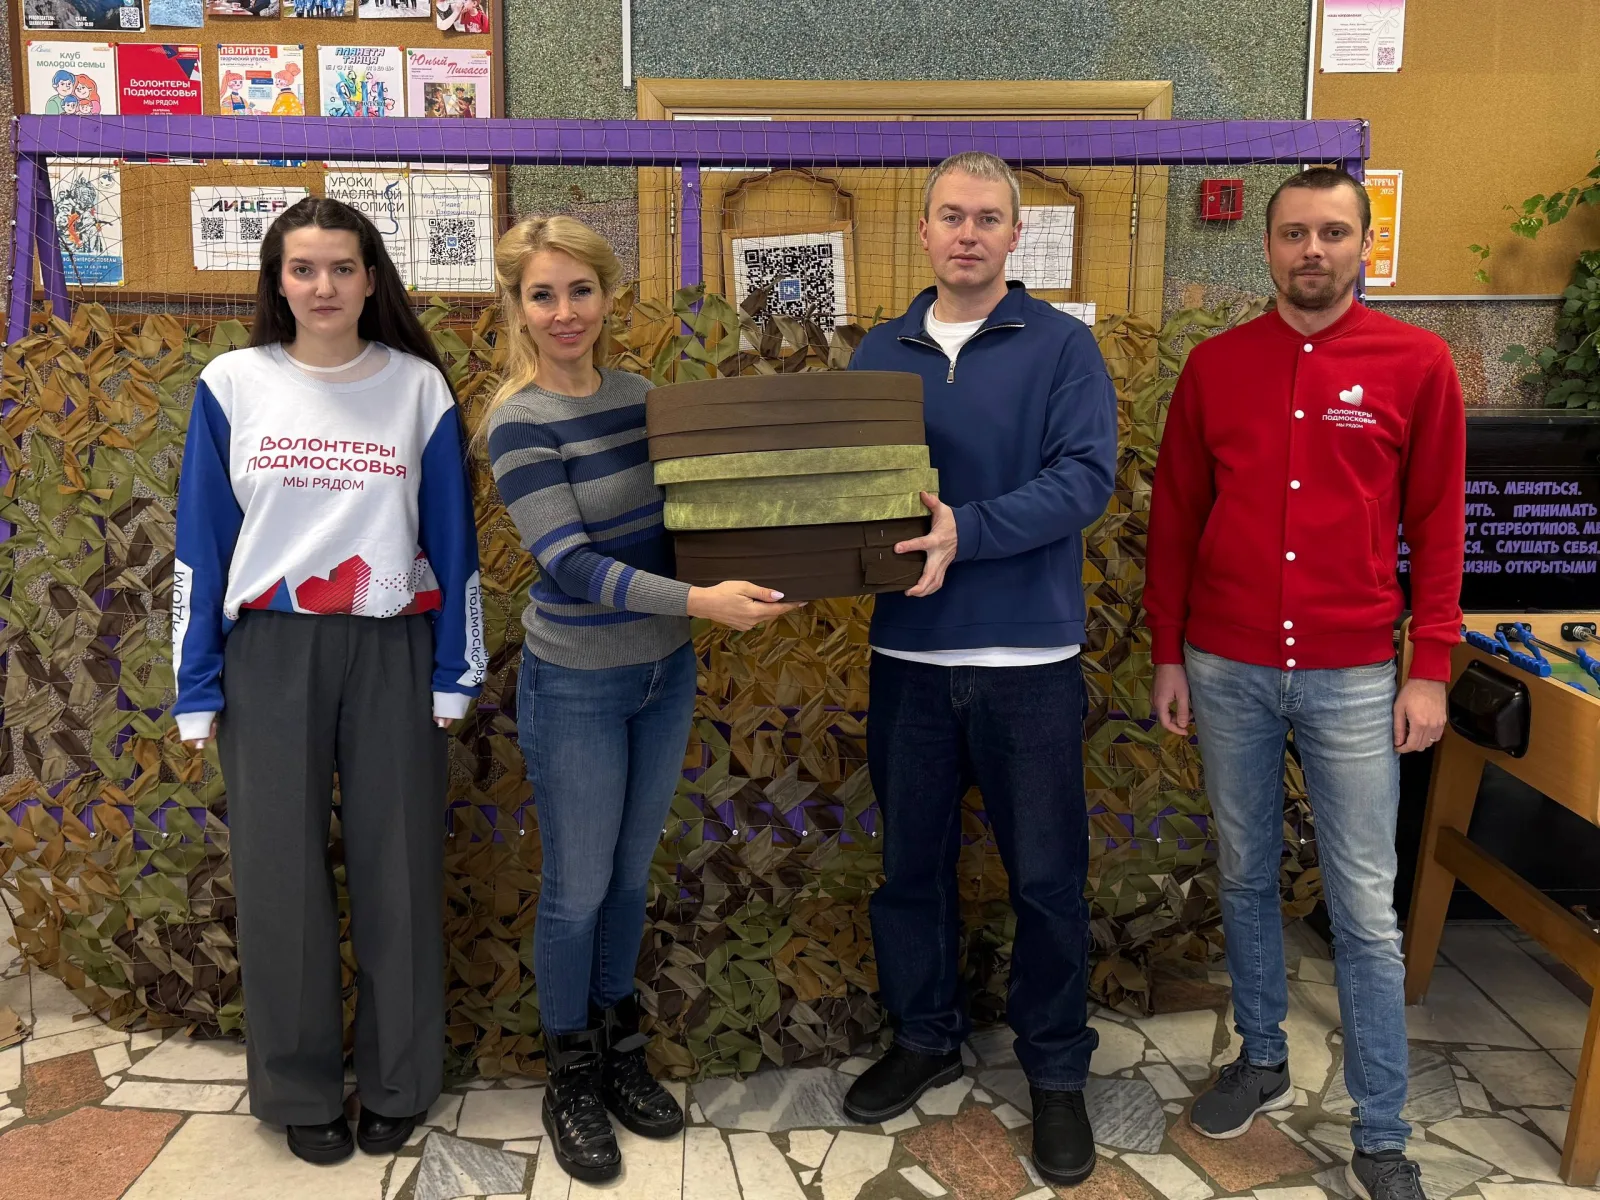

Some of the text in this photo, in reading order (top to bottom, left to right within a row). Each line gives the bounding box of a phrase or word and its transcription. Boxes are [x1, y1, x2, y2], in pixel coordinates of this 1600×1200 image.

[220, 46, 270, 56] палитра
[335, 48, 385, 57] ПЛАНЕТА
[343, 56, 379, 65] ТАНЦА
[447, 62, 488, 75] Пикассо
[330, 176, 373, 188] УРОКИ
[330, 188, 402, 200] МАСЛЯНОЙ
[208, 200, 288, 213] ЛИДЕР
[260, 436, 396, 458] ВОЛОНТЕРЫ
[246, 455, 407, 479] ПОДМОСКОВЬЯ
[282, 476, 364, 491] МЫ РЯДОМ
[1504, 481, 1582, 495] МЕНЯТЬСЯ.
[1513, 503, 1598, 518] ПРИНИМАТЬ
[1480, 522, 1580, 536] СТЕРЕОТИПОВ.
[1495, 540, 1560, 554] СЛУШАТЬ
[1505, 560, 1597, 574] ОТКРЫТЫМИ
[469, 585, 486, 685] ПОДМОСКОВЬЯ
